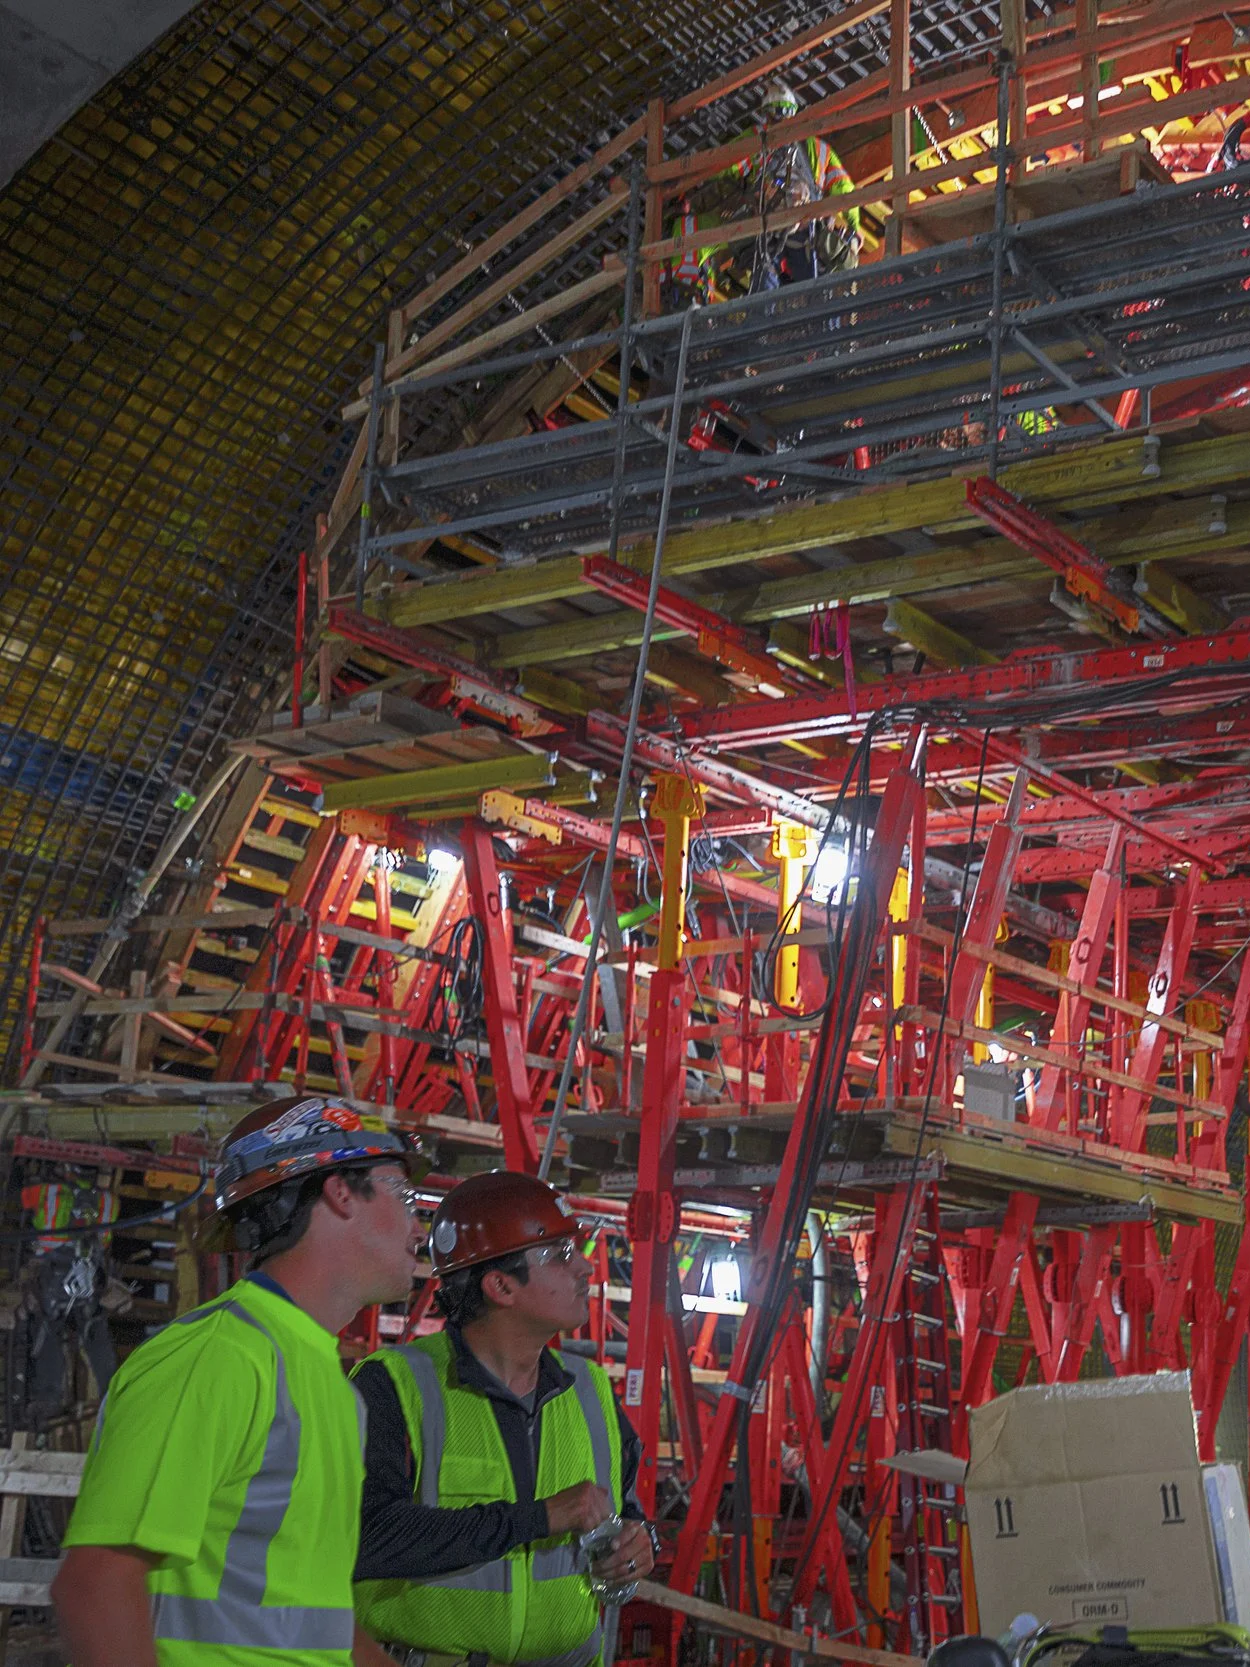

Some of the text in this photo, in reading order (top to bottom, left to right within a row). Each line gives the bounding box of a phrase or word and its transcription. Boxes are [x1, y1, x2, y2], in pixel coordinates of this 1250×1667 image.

[629, 1375, 637, 1398] PERI
[1049, 1578, 1145, 1595] CONSUMER COMMODITY
[1082, 1603, 1119, 1617] ORM-D
